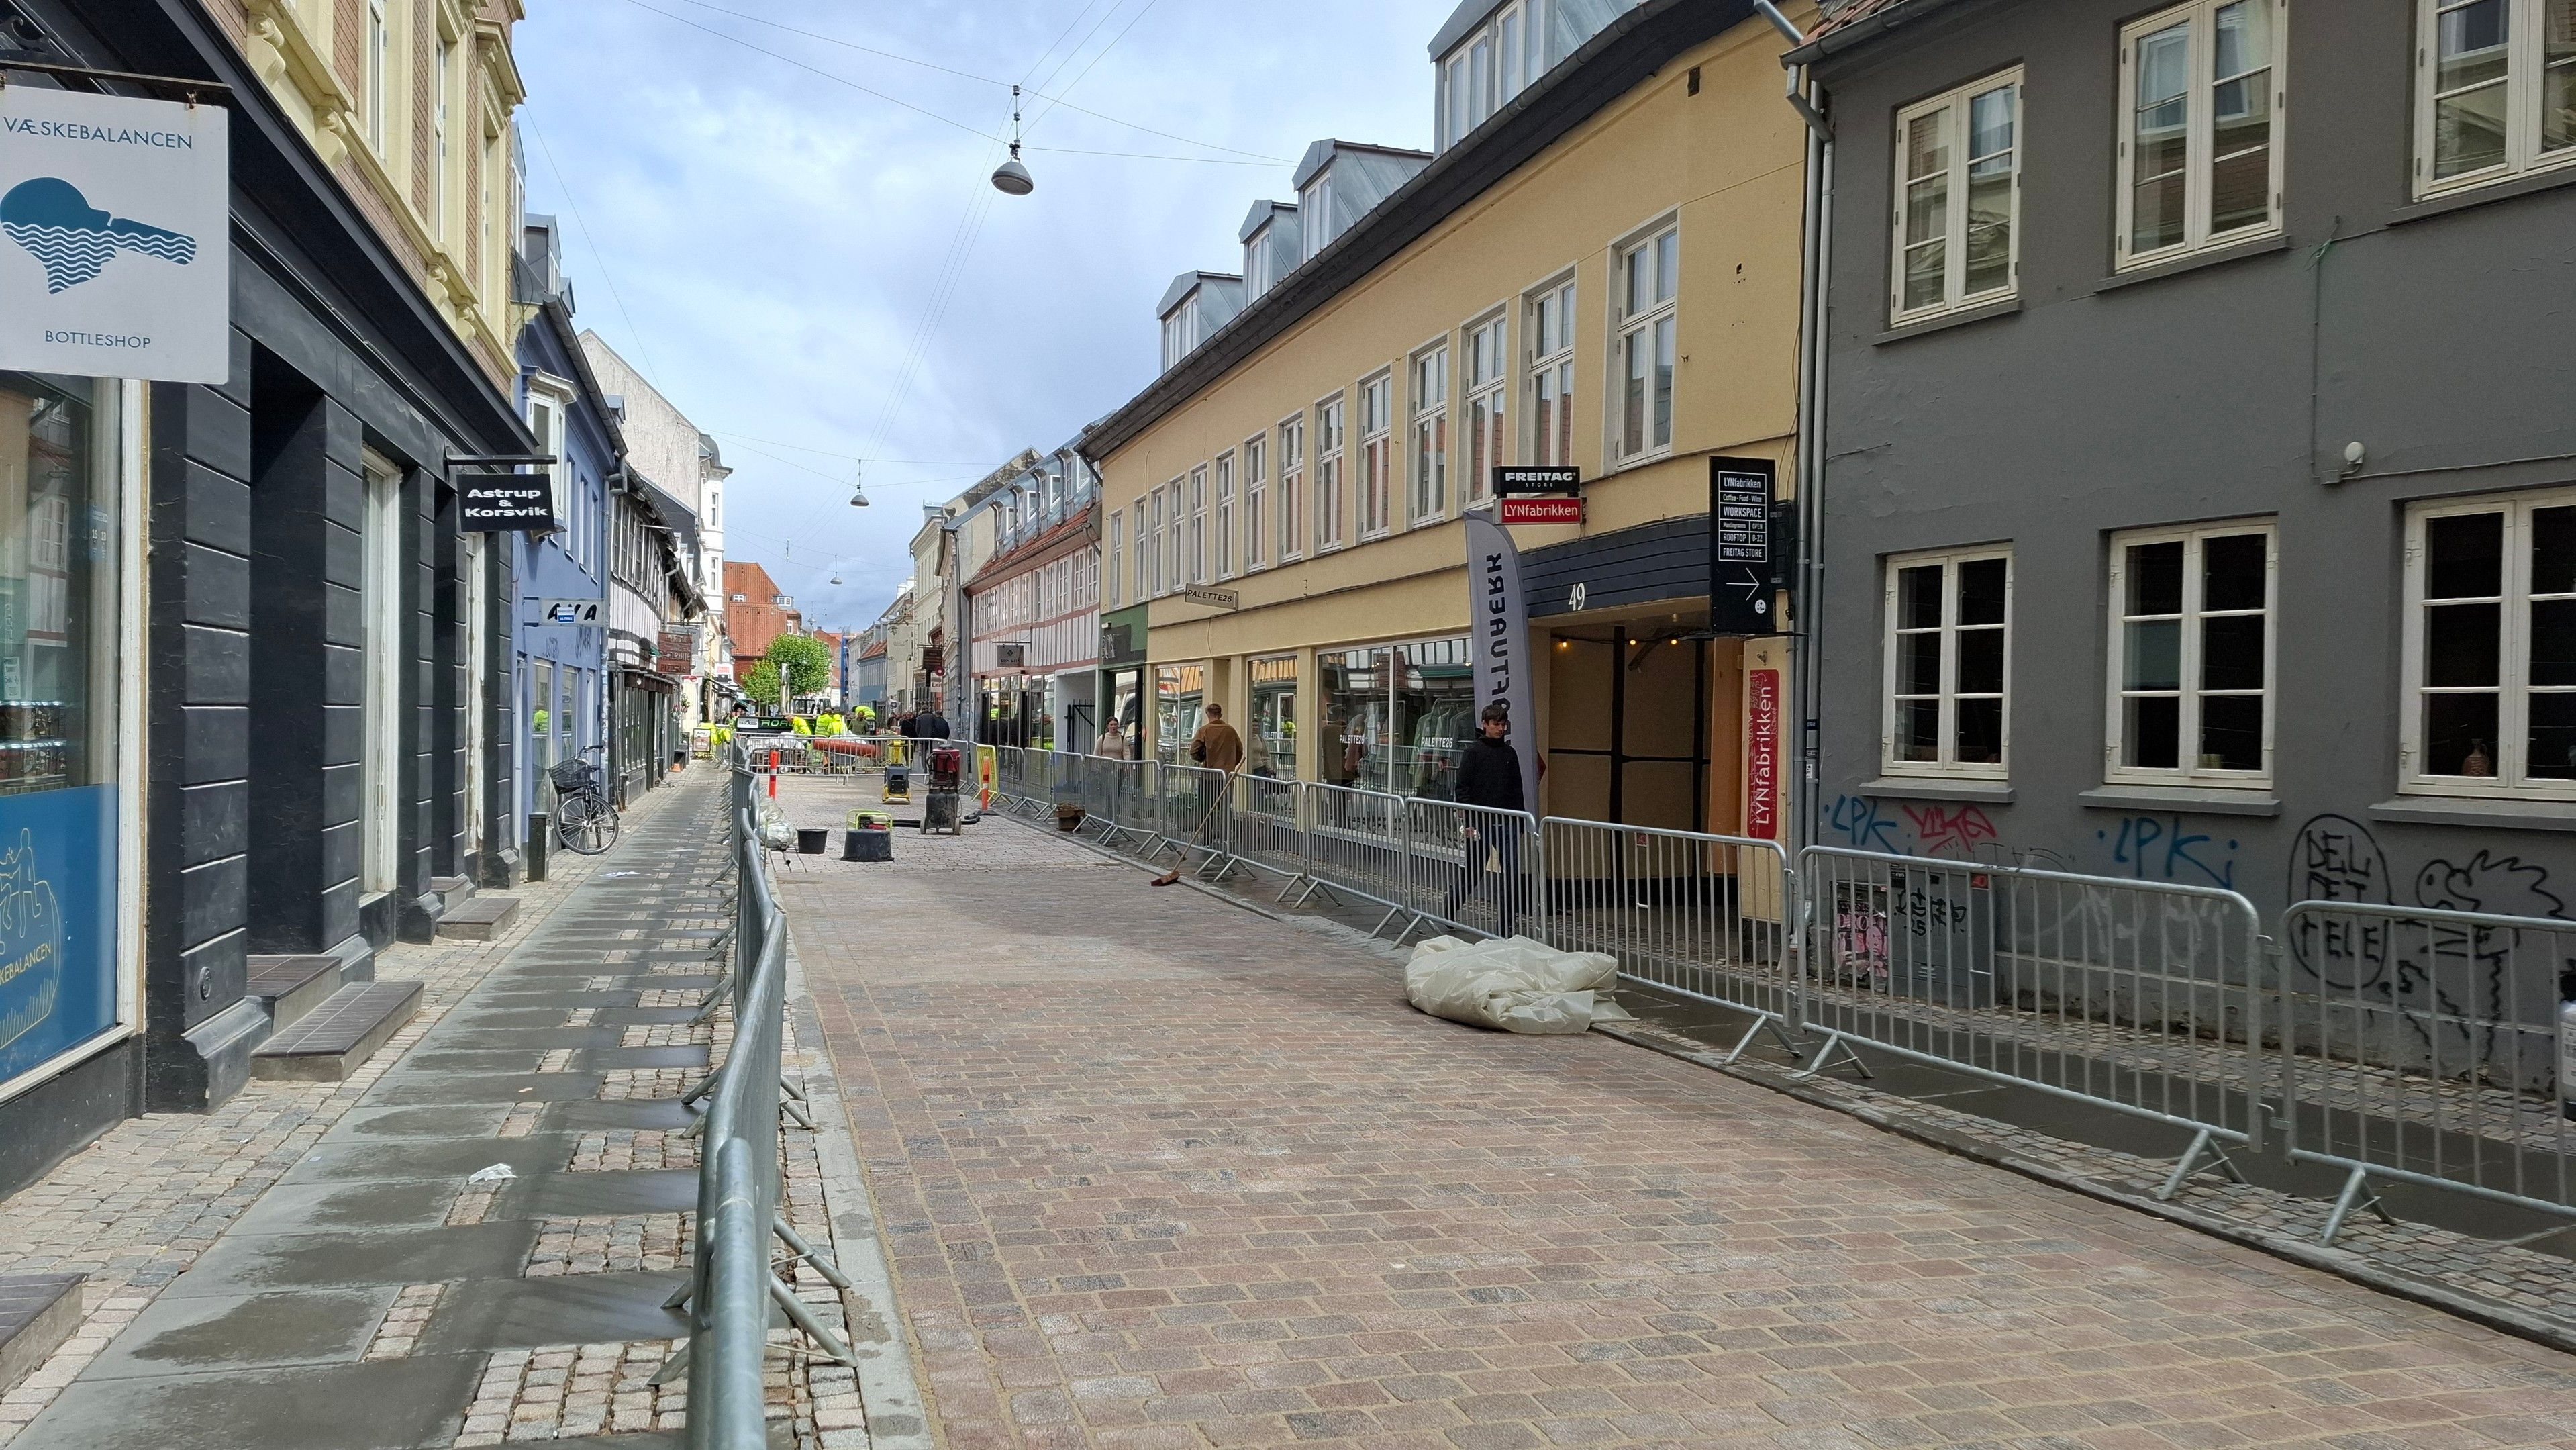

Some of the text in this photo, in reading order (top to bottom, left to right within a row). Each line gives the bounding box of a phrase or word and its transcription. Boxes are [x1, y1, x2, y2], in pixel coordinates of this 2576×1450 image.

[3, 116, 193, 150] VÆSKEBALANCEN
[45, 330, 151, 349] BOTTLESHOP
[1505, 472, 1573, 481] FREITAG
[1724, 477, 1761, 489] LYNfabrikken
[467, 489, 541, 499] Astrup
[1722, 493, 1737, 501] Coffee
[1738, 494, 1749, 502] Food
[464, 506, 548, 518] Korsvik
[1504, 504, 1578, 517] LYNfabrikken
[1723, 506, 1762, 518] WORKSPACE
[1723, 533, 1746, 542] ROOFTOP
[1723, 547, 1763, 558] FREITAG STORE
[1187, 589, 1233, 603] PALETTE26
[1568, 582, 1585, 611] 49
[1339, 734, 1365, 744] PALETTE26
[1421, 737, 1453, 748] PALETTE26
[1755, 687, 1771, 824] LYNfabrikken
